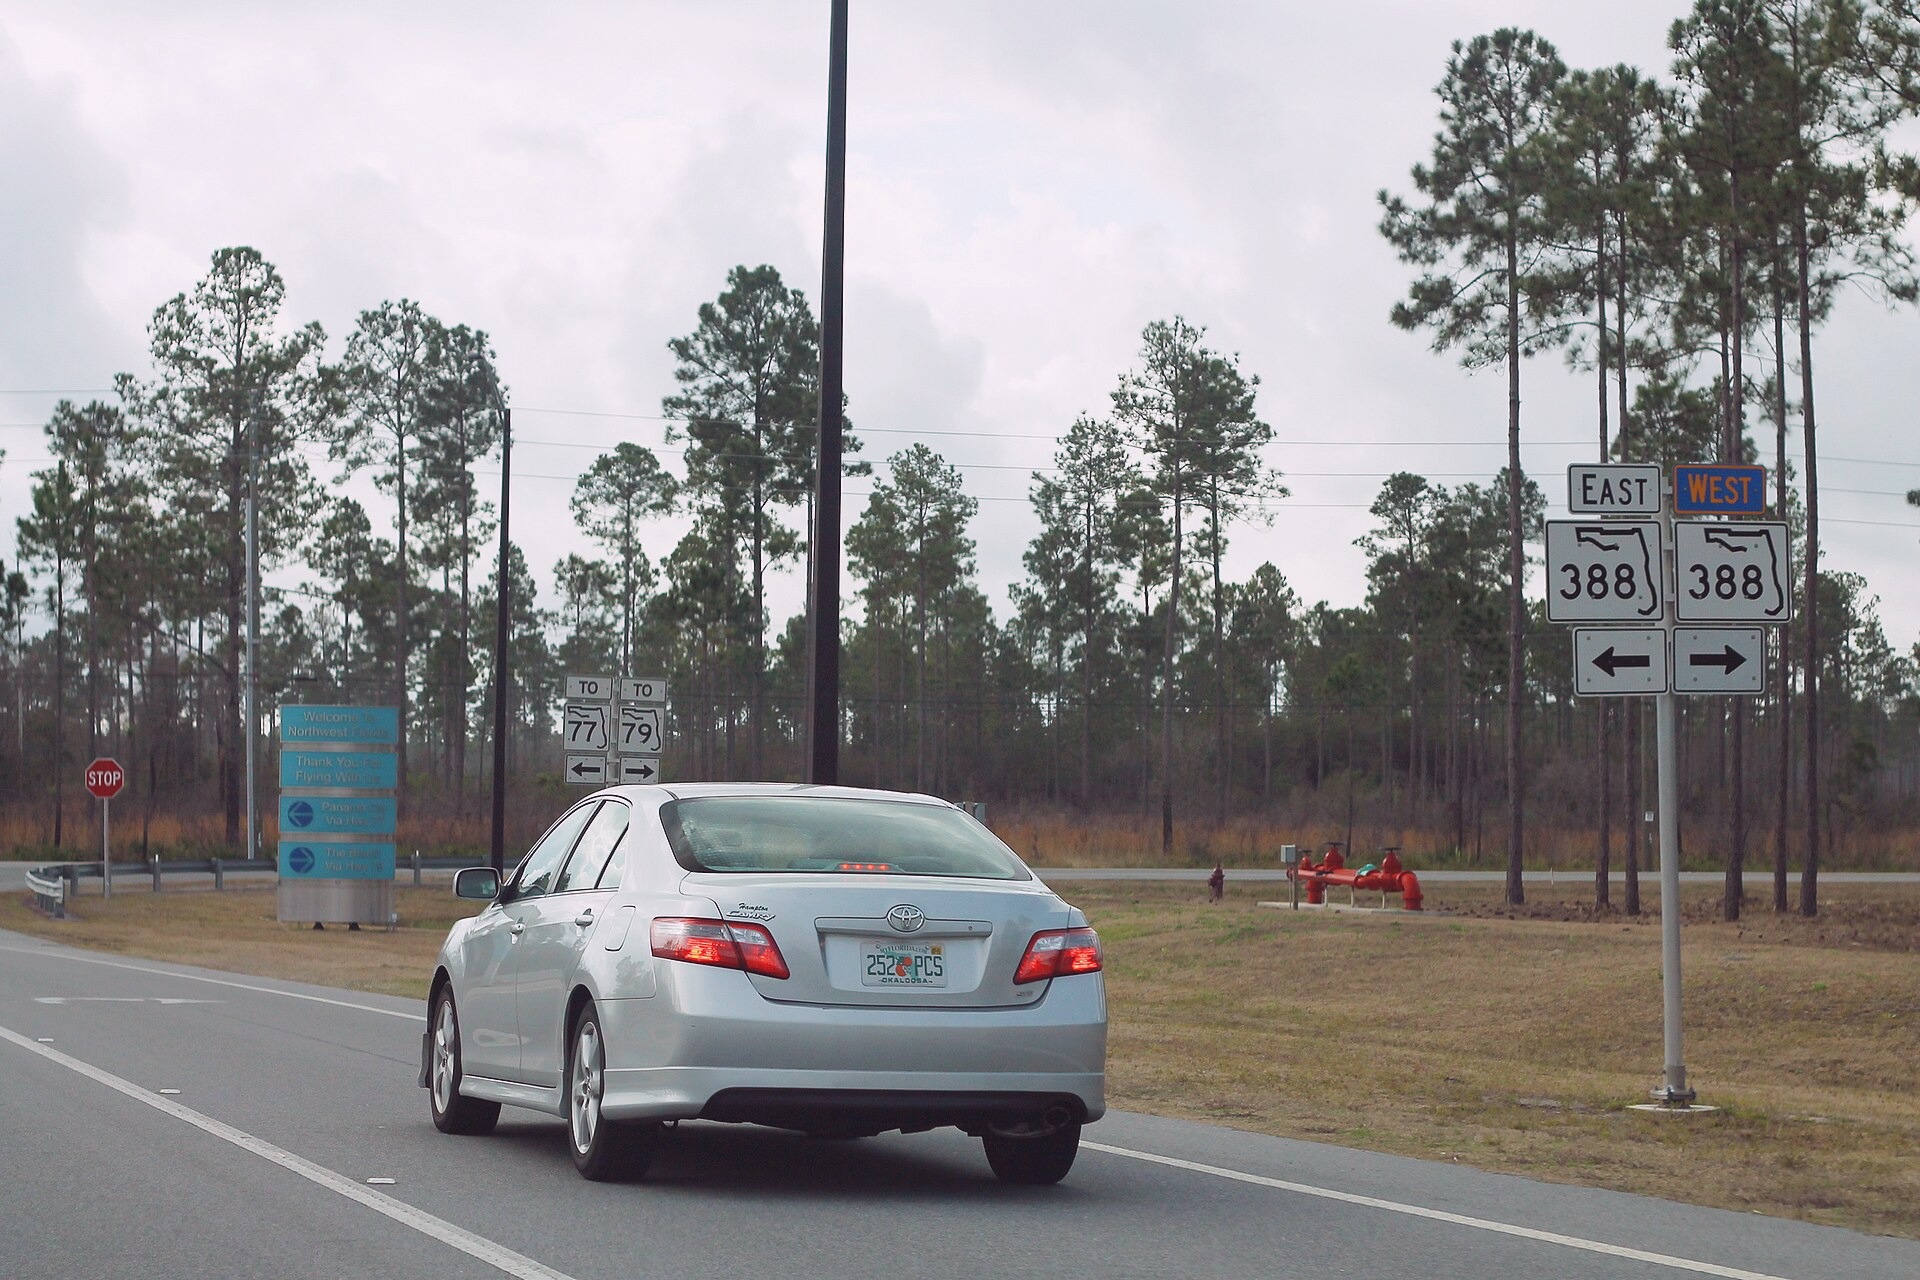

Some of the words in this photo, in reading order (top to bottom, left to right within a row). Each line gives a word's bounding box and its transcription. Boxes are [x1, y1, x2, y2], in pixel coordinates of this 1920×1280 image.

[1582, 473, 1648, 505] EAST
[1687, 473, 1752, 504] WEST
[1559, 563, 1636, 600] 388
[1688, 564, 1764, 600] 388
[579, 681, 599, 695] TO
[633, 684, 653, 697] TO
[303, 711, 358, 723] Welcome
[288, 726, 347, 737] Northwest
[568, 721, 597, 742] 77
[622, 723, 652, 744] 79
[296, 755, 333, 768] Thank
[88, 771, 121, 786] STOP
[296, 770, 331, 784] Flying
[866, 954, 896, 976] 252
[914, 955, 943, 977] PCS
